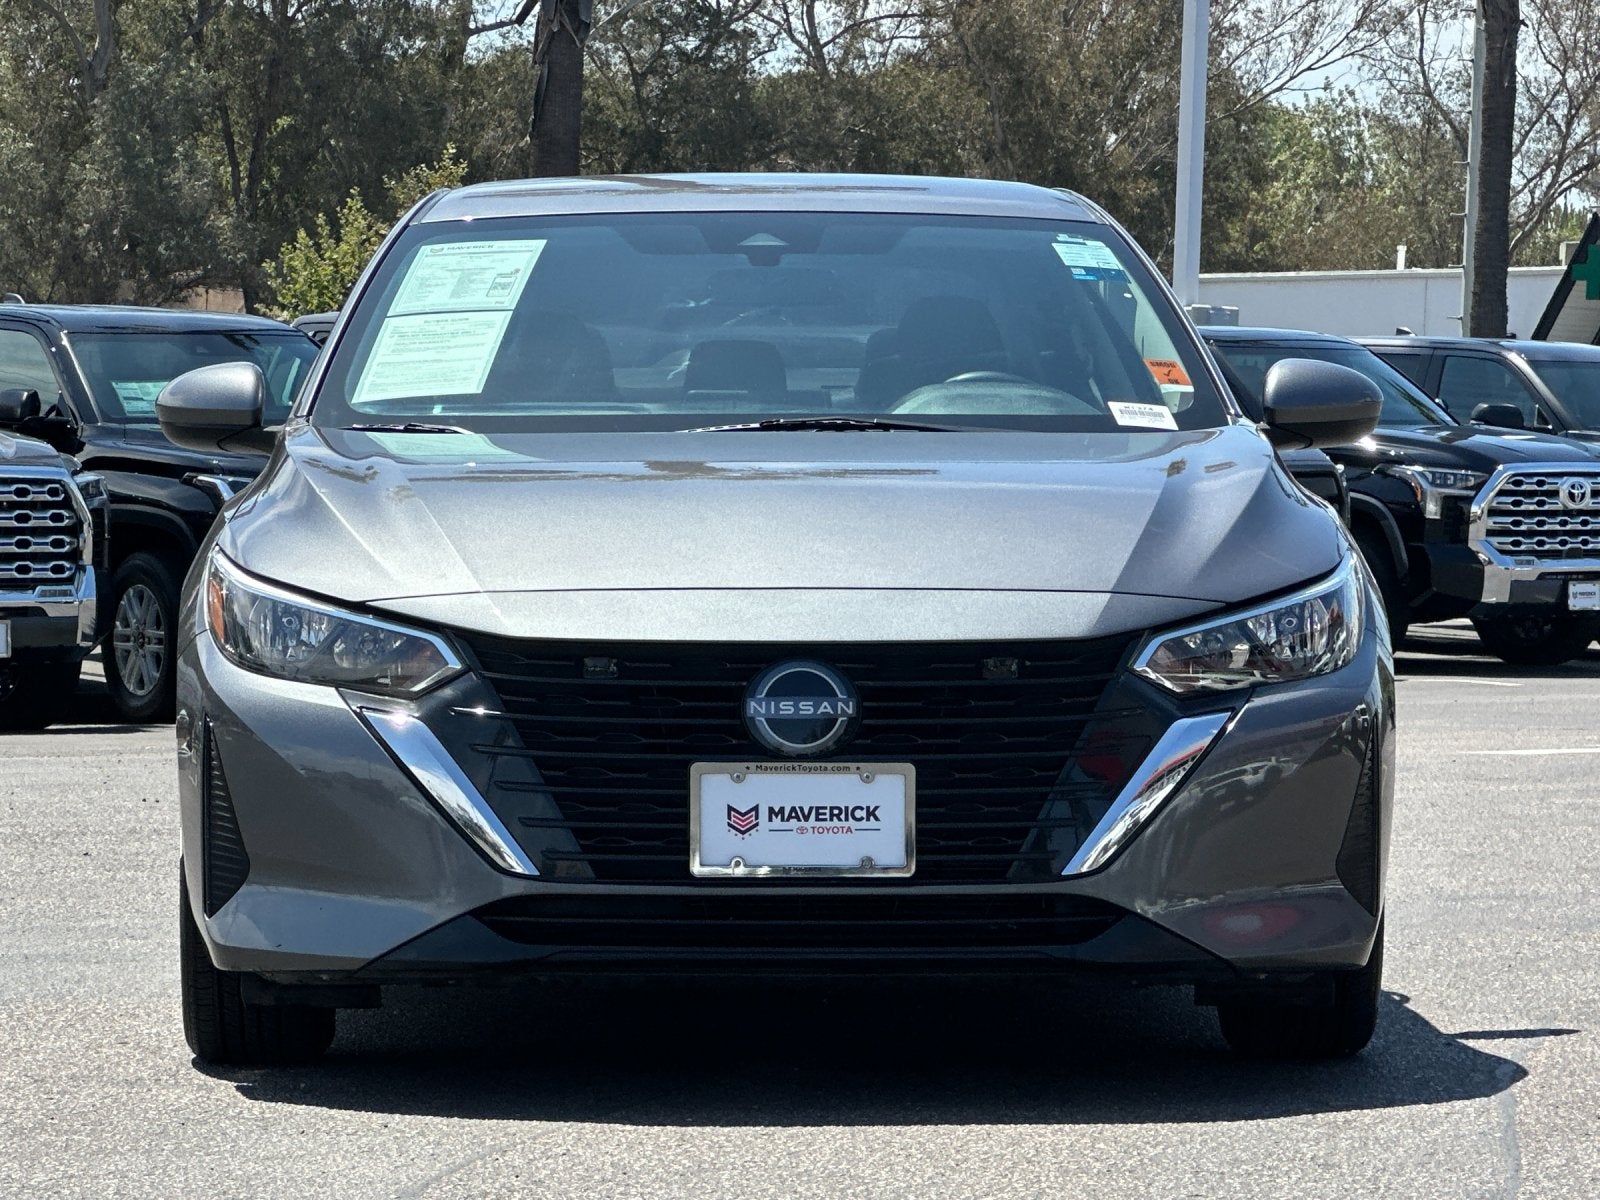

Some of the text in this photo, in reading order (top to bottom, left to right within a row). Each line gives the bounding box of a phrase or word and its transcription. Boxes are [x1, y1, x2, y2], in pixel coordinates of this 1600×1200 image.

[750, 701, 853, 714] NISSAN
[755, 764, 851, 773] MaverickToyota.com
[768, 805, 881, 822] MAVERICK
[811, 826, 853, 834] TOYOTA
